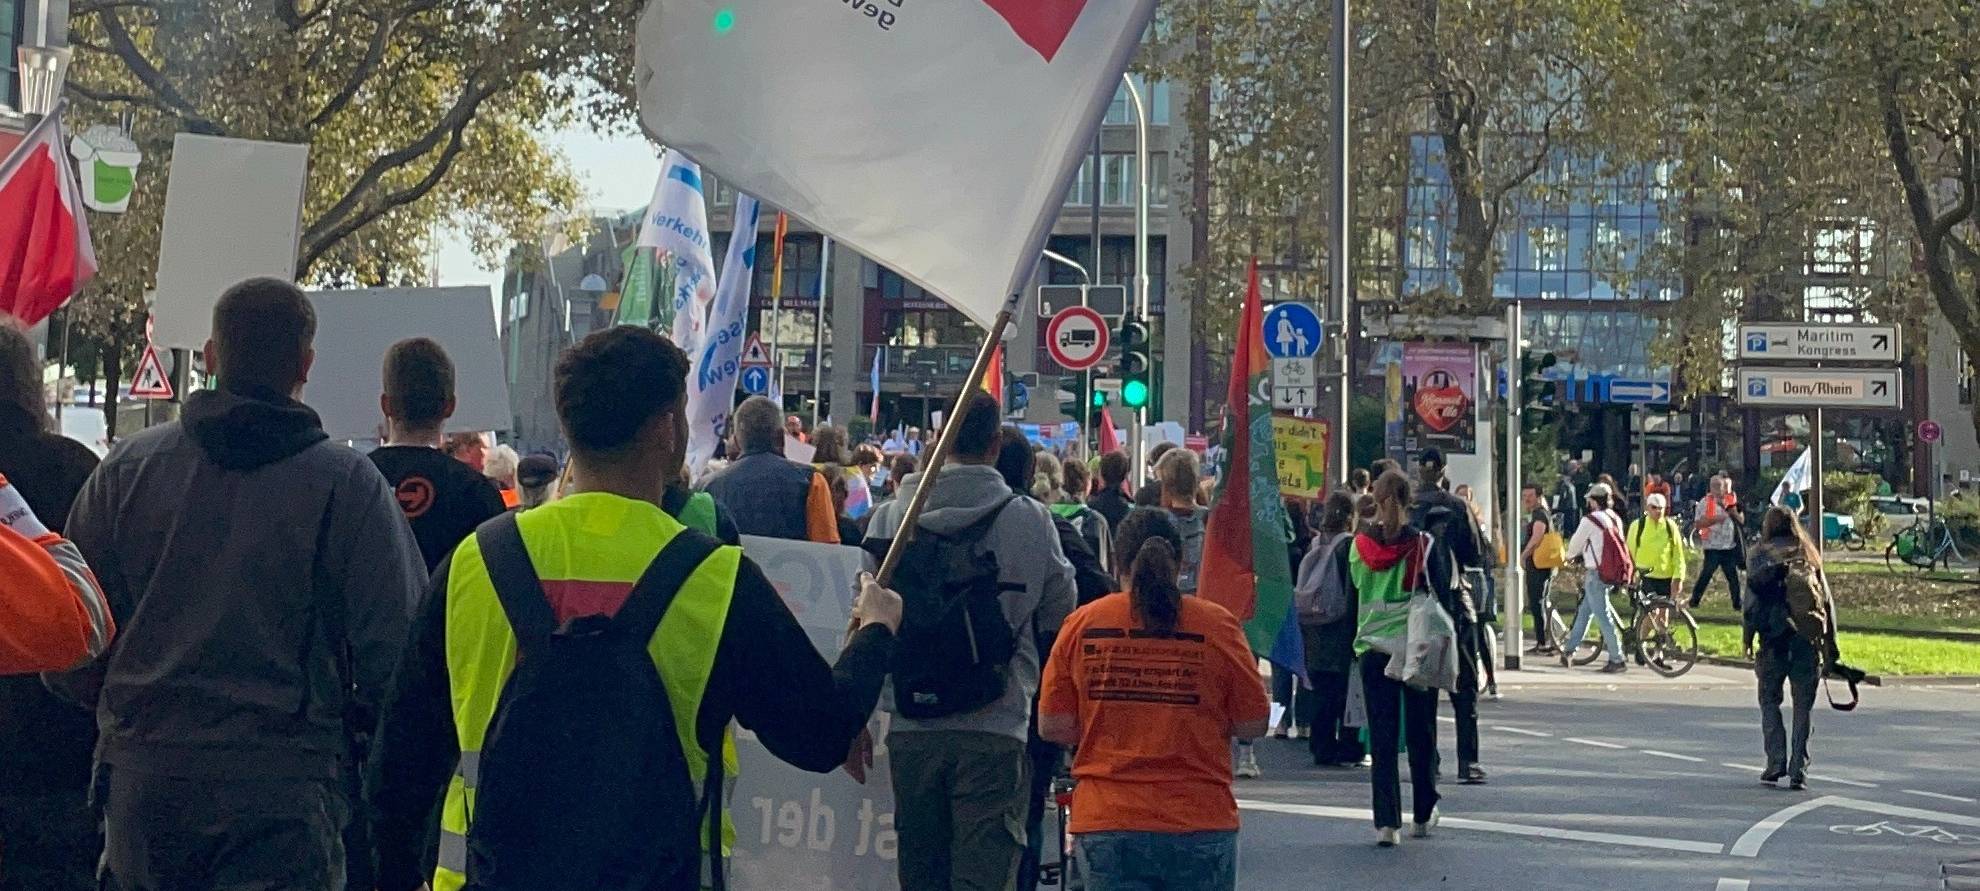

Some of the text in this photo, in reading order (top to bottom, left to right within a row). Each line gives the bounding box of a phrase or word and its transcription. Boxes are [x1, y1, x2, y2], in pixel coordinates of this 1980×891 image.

[1797, 329, 1854, 343] Maritim
[1797, 345, 1856, 356] Kongress
[1783, 381, 1852, 396] Dom/Rhein
